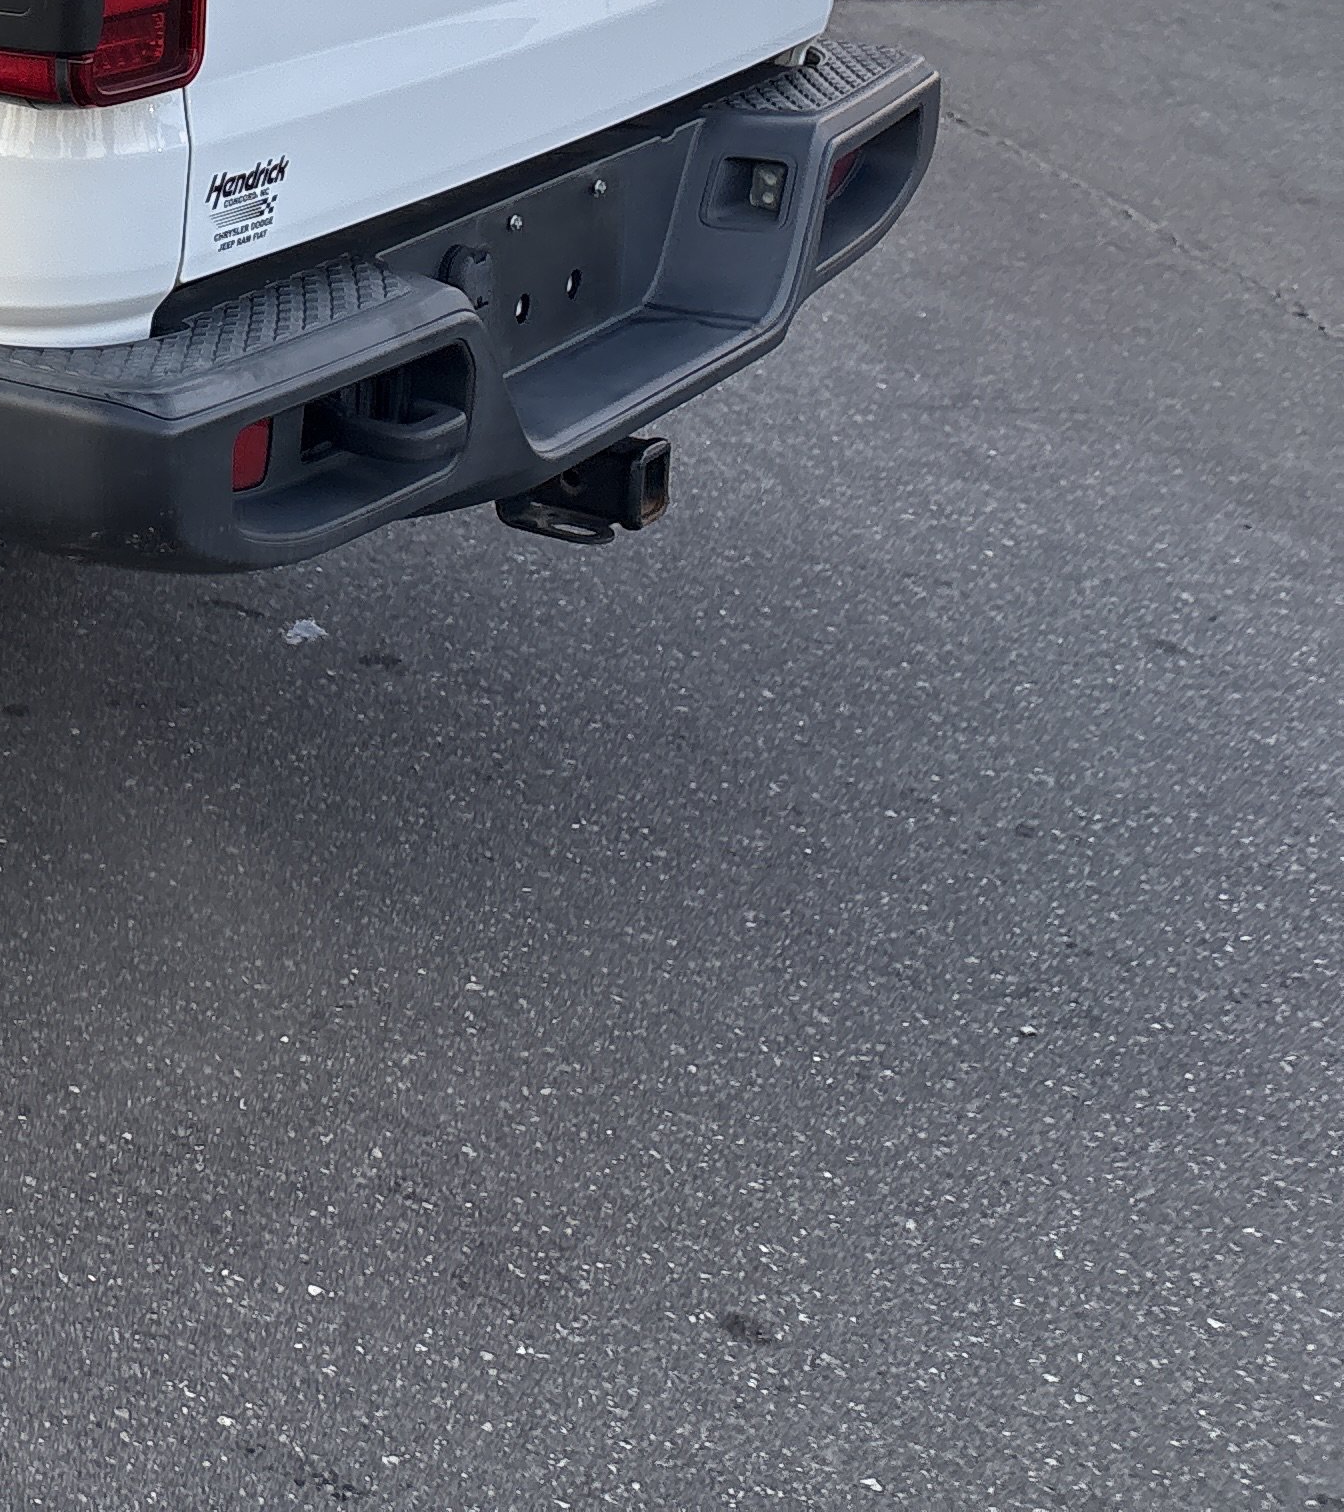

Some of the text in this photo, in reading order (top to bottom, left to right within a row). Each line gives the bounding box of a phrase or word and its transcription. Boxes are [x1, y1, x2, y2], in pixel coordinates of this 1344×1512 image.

[205, 155, 289, 210] Hendrick
[214, 216, 274, 242] CHRYSLER DODGE
[218, 229, 268, 252] JEEP RAM FIAT
